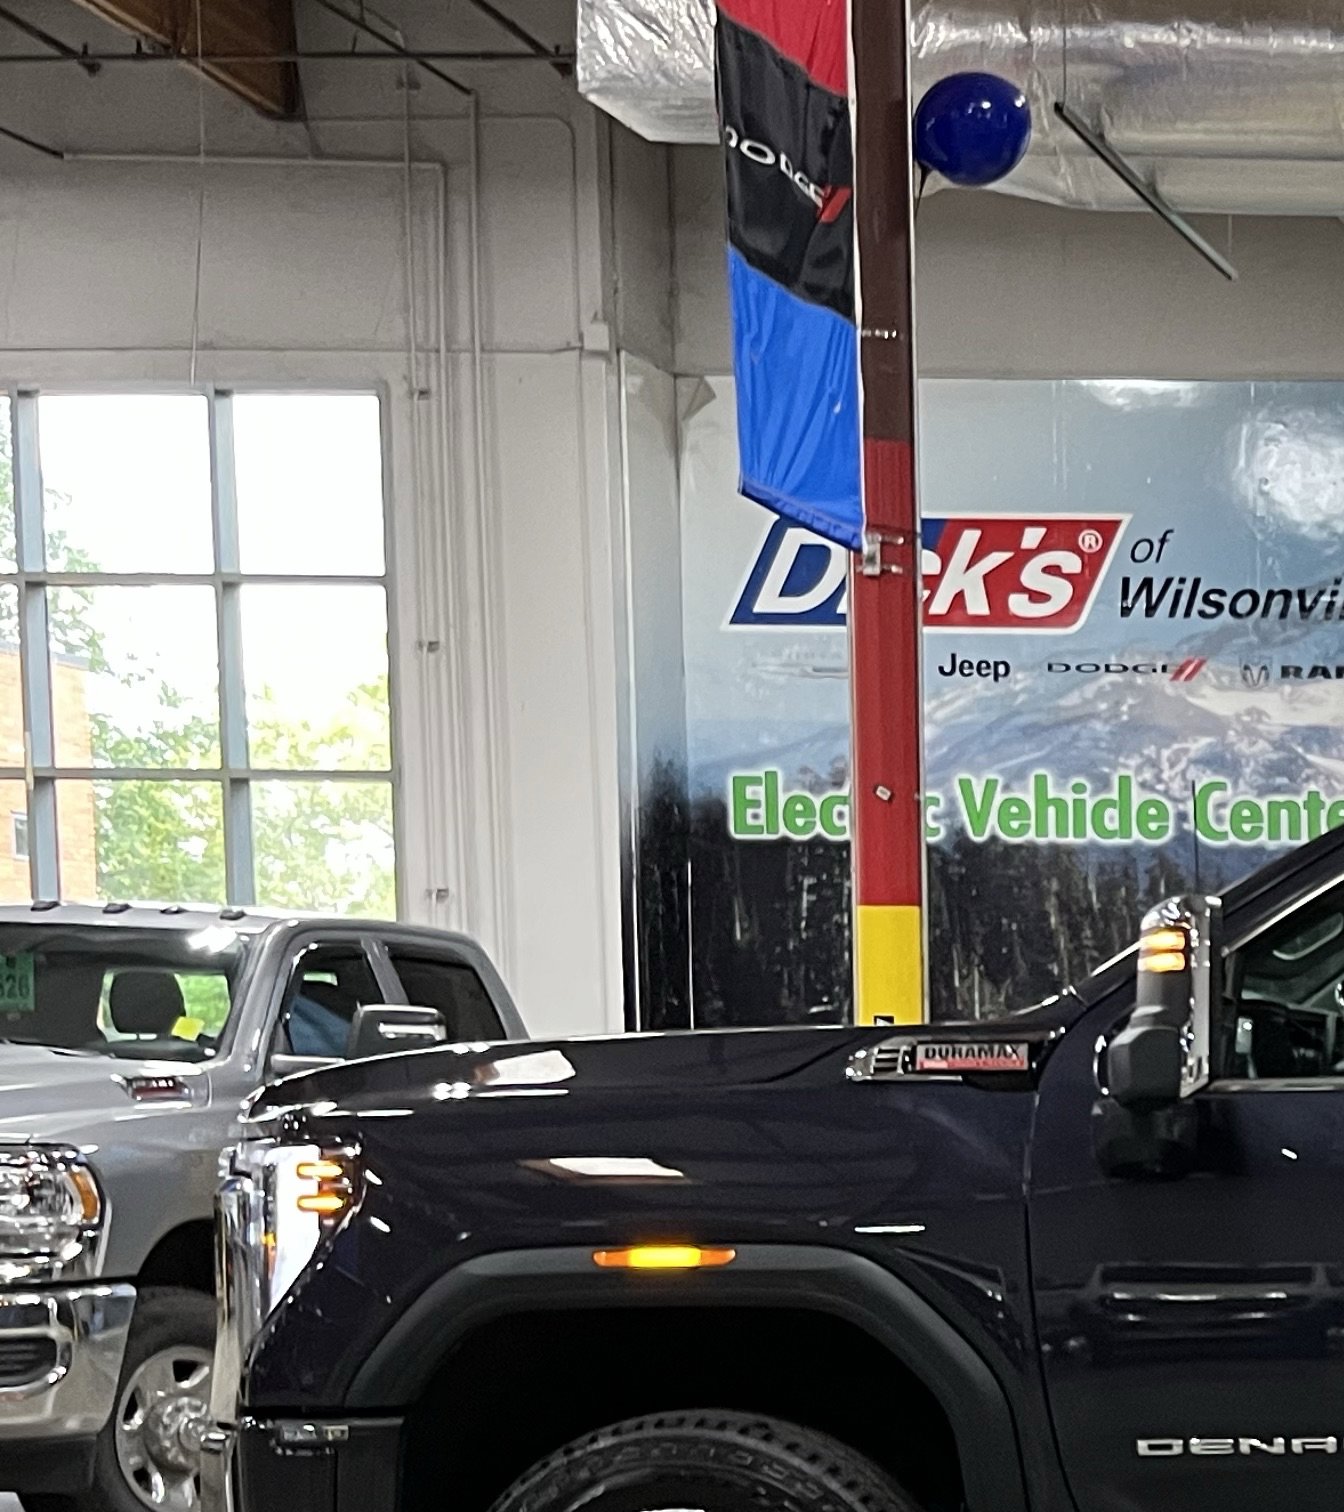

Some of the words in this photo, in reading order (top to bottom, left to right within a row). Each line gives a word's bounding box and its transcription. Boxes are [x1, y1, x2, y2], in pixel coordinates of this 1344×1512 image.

[1130, 529, 1174, 563] of
[937, 653, 1011, 682] Jeep
[958, 773, 1170, 839] Vehicle
[924, 1044, 1020, 1060] DURAMAX
